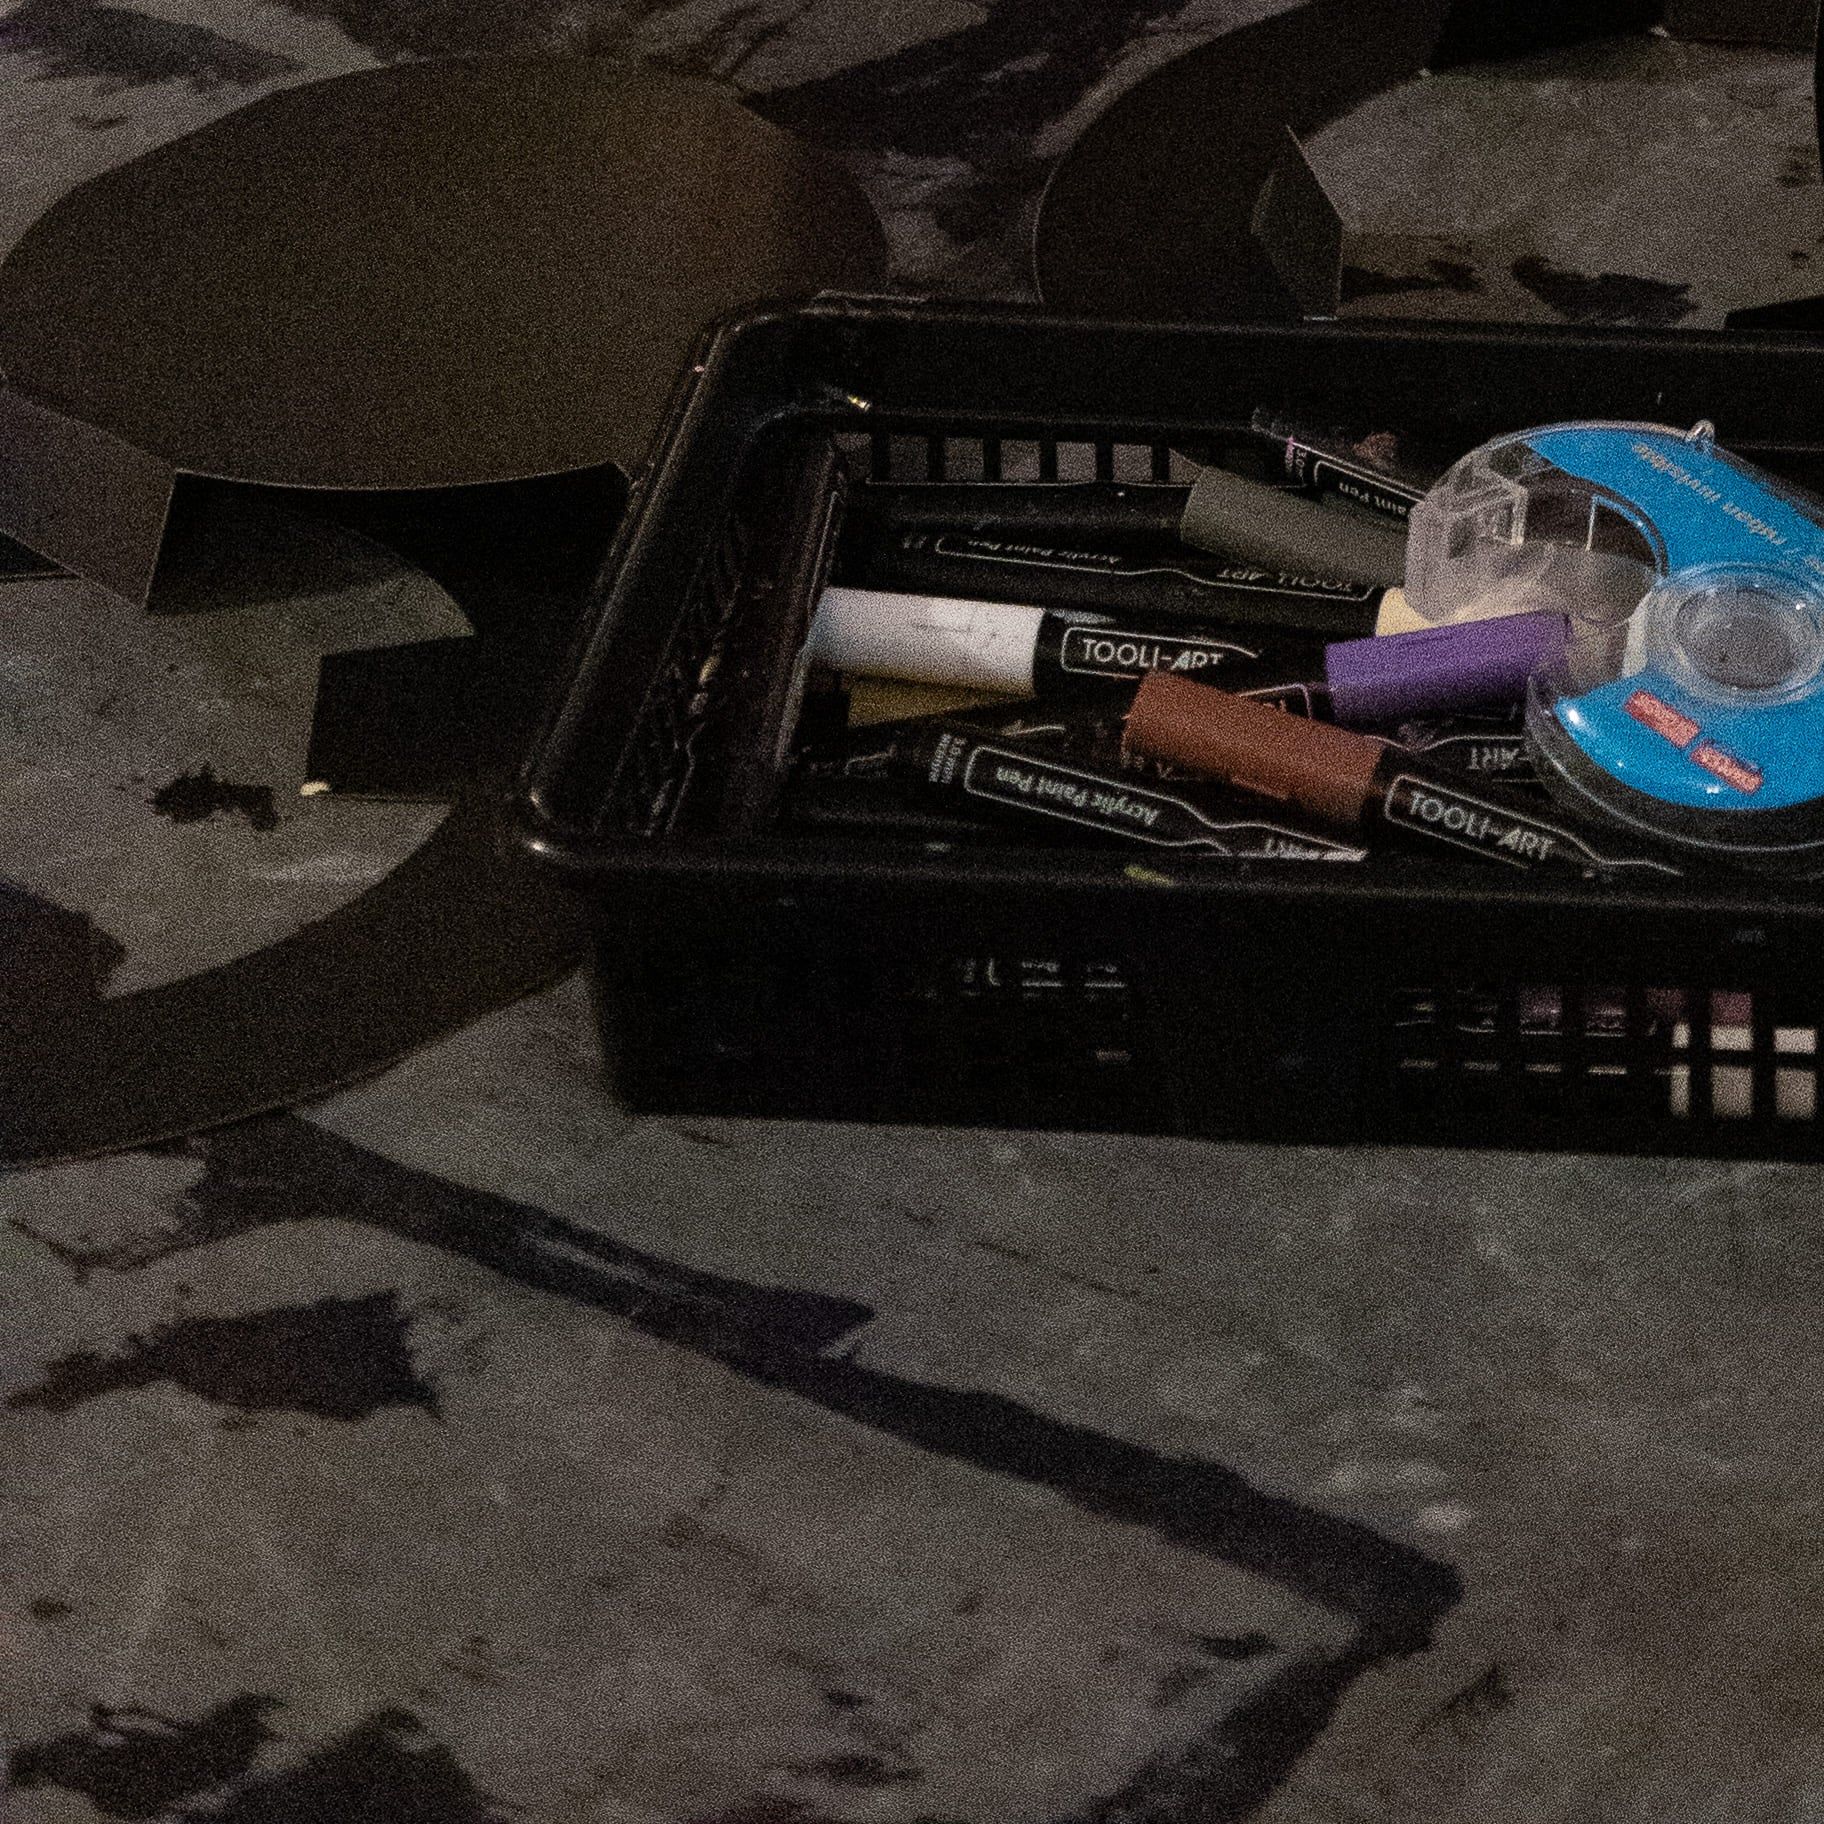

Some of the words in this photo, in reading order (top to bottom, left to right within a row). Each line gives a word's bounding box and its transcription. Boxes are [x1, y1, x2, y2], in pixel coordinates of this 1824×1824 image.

[1631, 443, 1721, 505] invisible
[1721, 500, 1788, 547] ruban
[1081, 636, 1225, 672] TOOLI-ART
[995, 765, 1034, 794] Pen
[1035, 776, 1090, 808] Paint
[1091, 791, 1161, 826] Acrylic
[1407, 790, 1555, 863] TOOLI-ART
